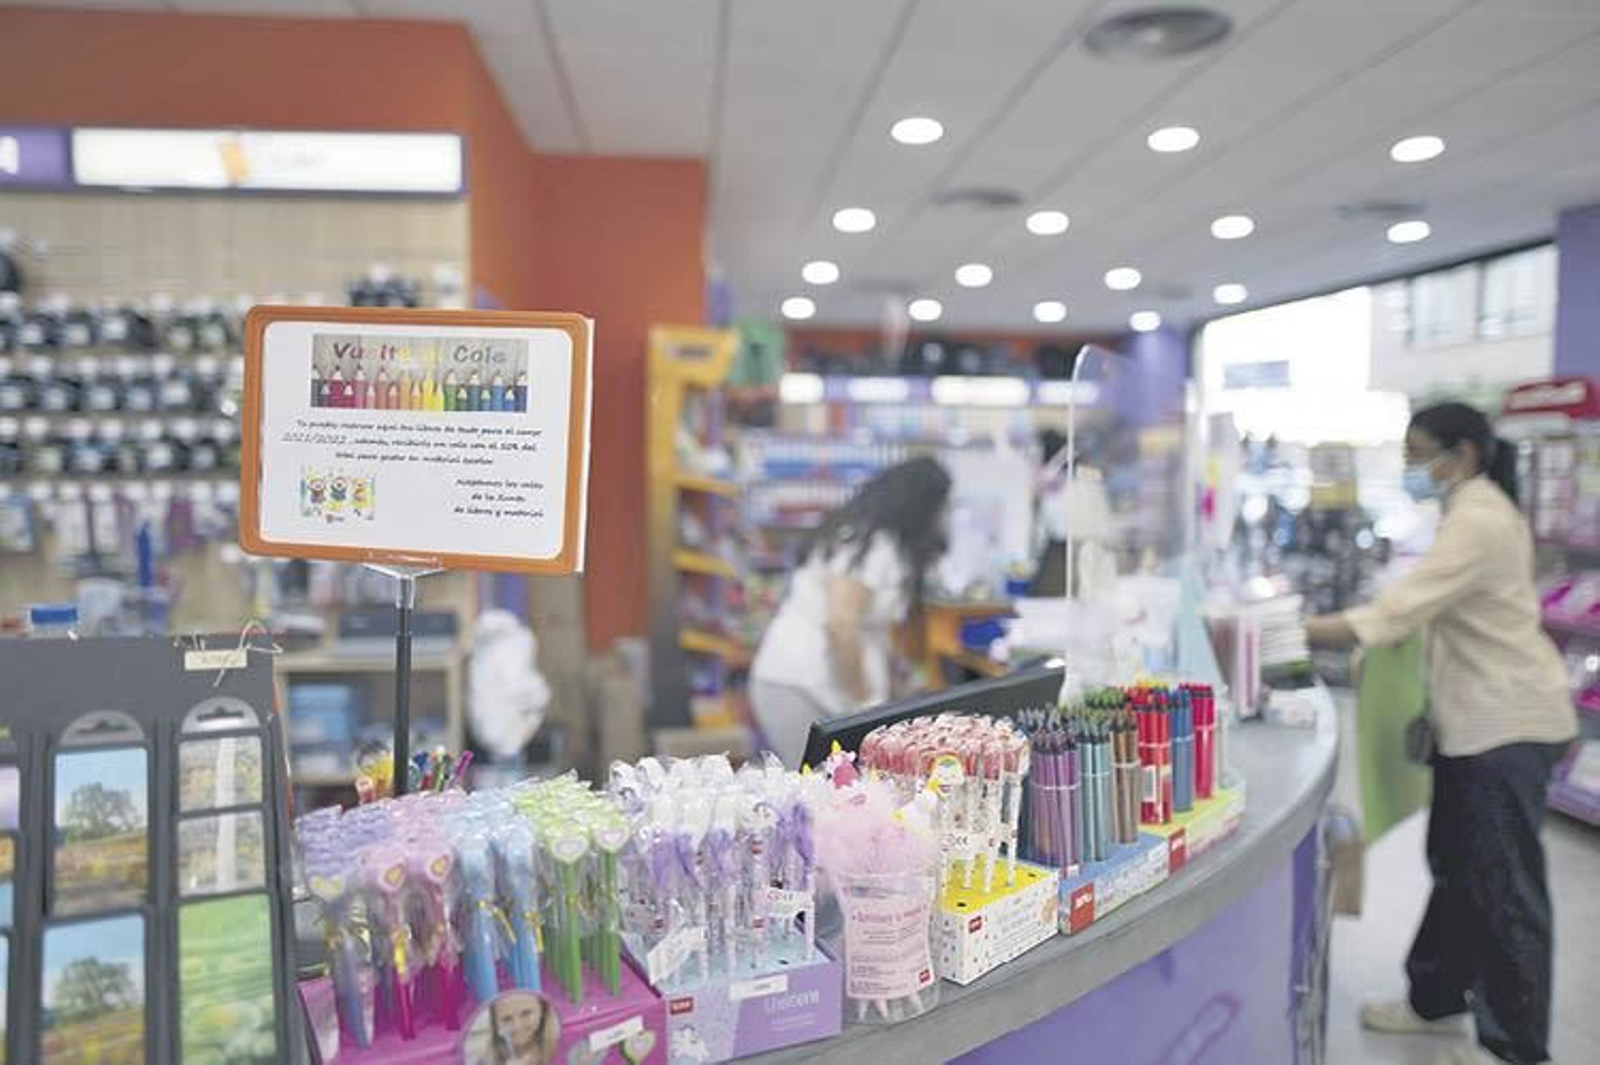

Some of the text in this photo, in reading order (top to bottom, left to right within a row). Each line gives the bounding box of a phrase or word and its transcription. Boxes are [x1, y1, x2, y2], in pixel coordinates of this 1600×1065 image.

[453, 345, 508, 363] Cole
[471, 492, 482, 501] de
[454, 506, 465, 514] de
